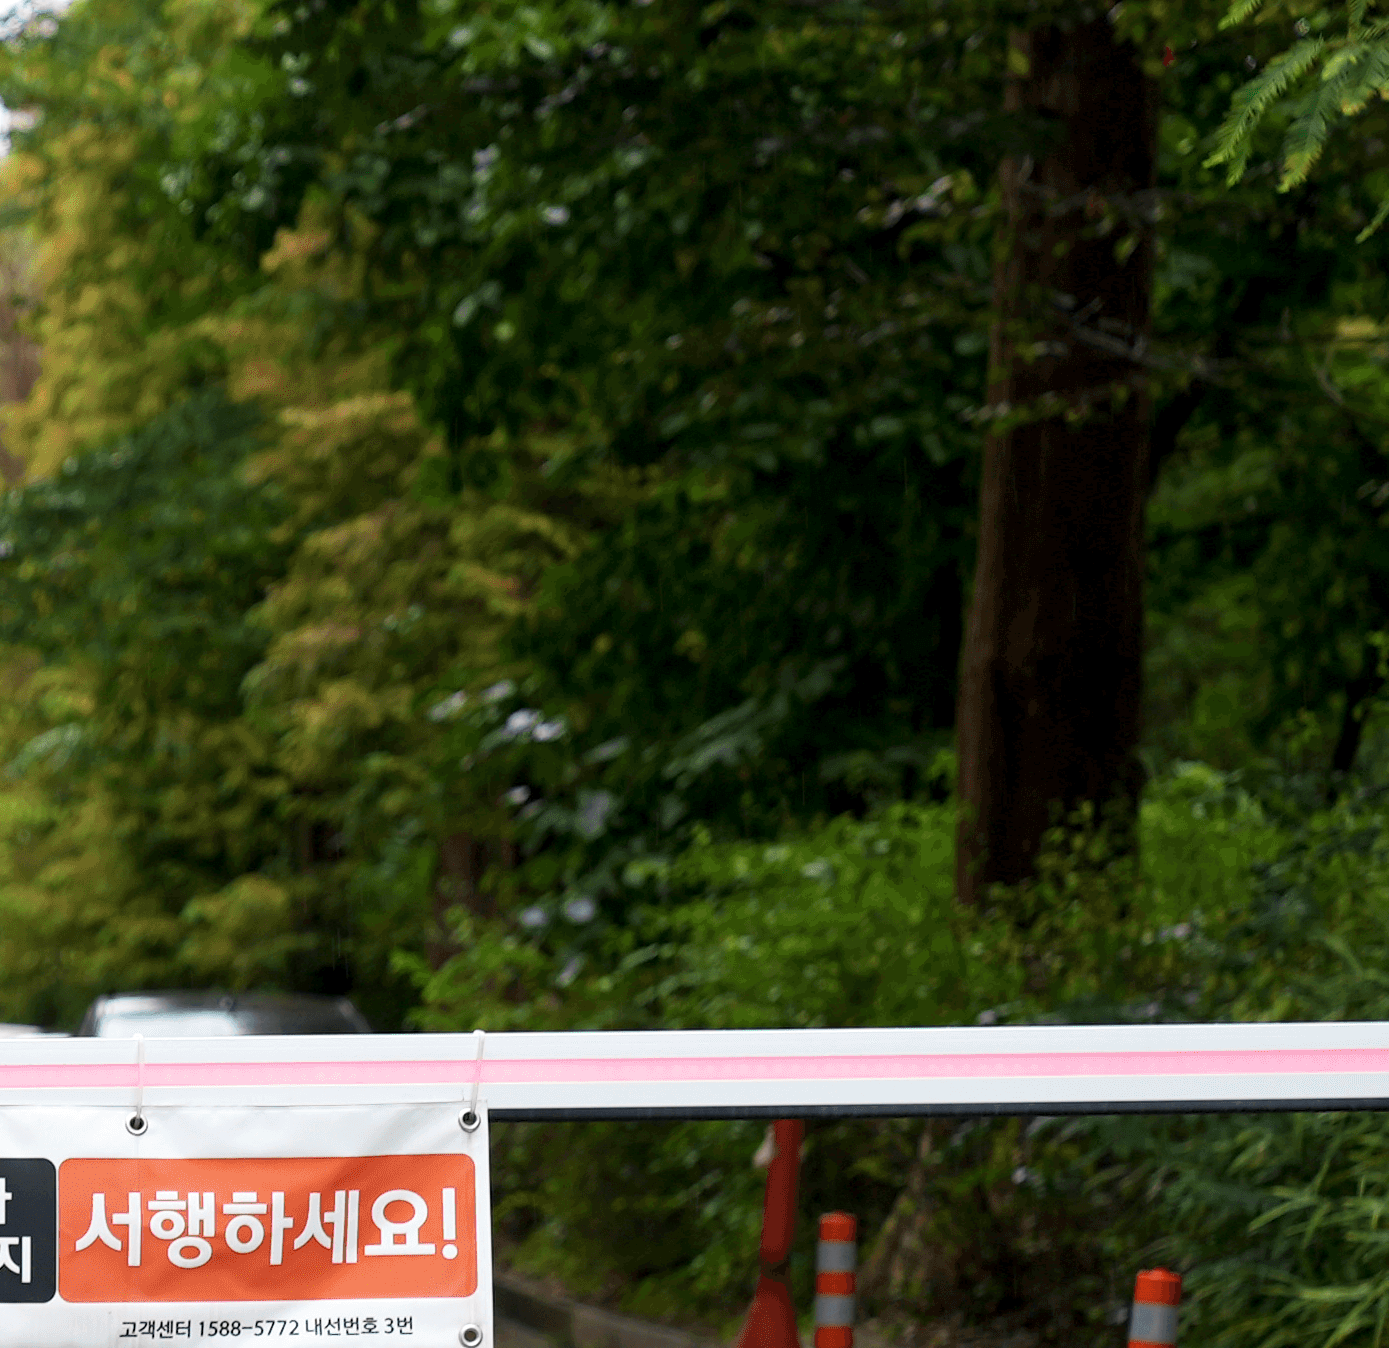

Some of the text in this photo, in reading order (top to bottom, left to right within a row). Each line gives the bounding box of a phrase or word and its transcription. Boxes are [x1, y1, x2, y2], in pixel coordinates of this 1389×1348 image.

[74, 1187, 459, 1269] 서행하세요!
[119, 1315, 414, 1339] 고객센터 1588-5772 내선번호 3번
